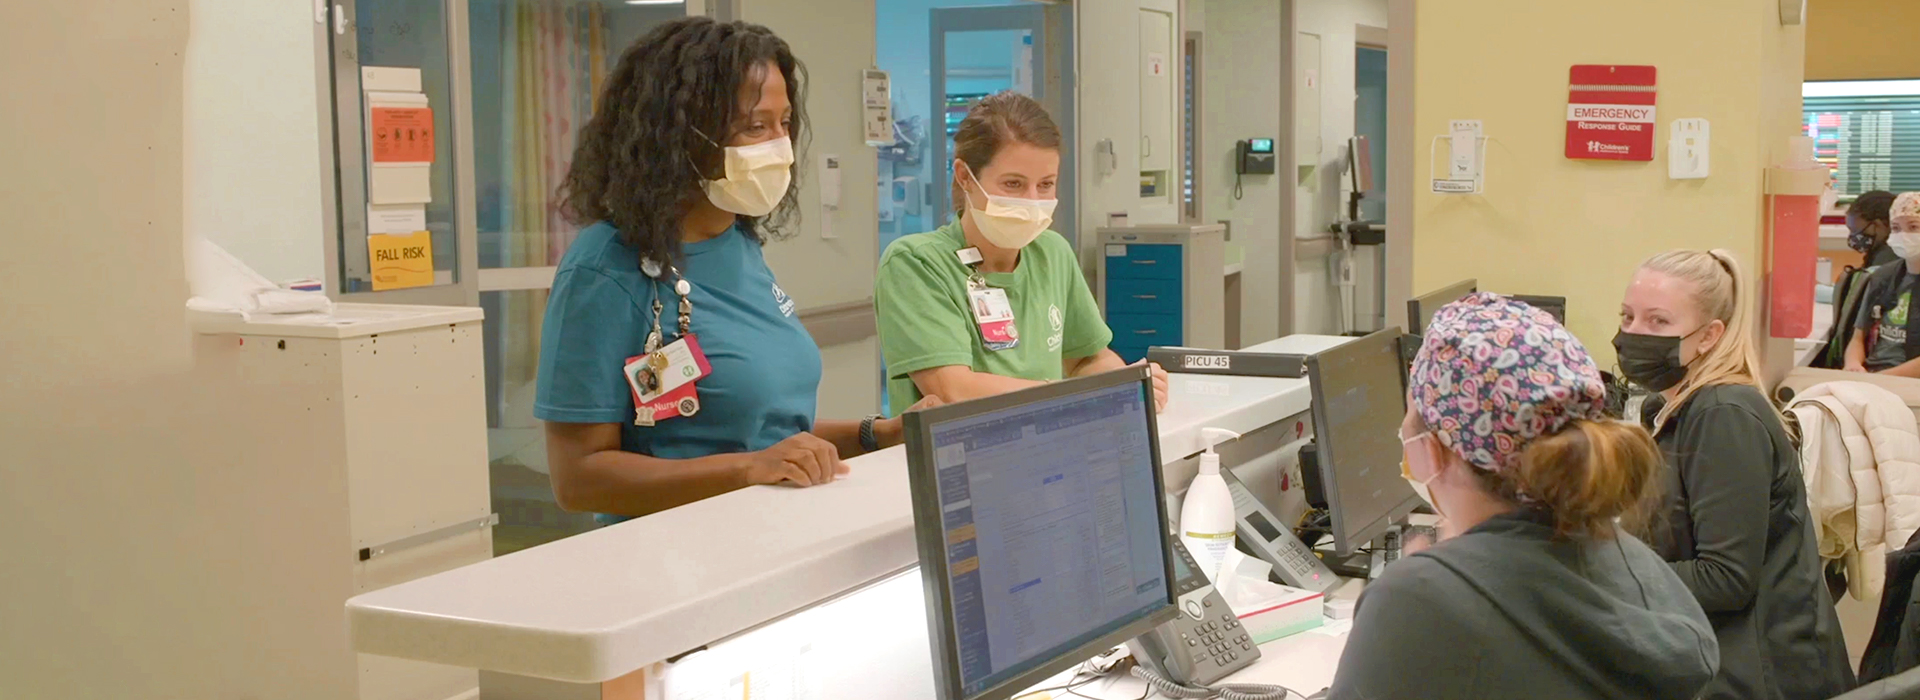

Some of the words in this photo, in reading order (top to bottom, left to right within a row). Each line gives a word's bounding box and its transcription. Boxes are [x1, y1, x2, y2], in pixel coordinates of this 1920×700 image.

[1574, 108, 1649, 119] EMERGENCY
[376, 248, 400, 262] FALL
[402, 246, 425, 260] RISK
[1186, 356, 1212, 367] PICU
[1214, 357, 1228, 367] 45
